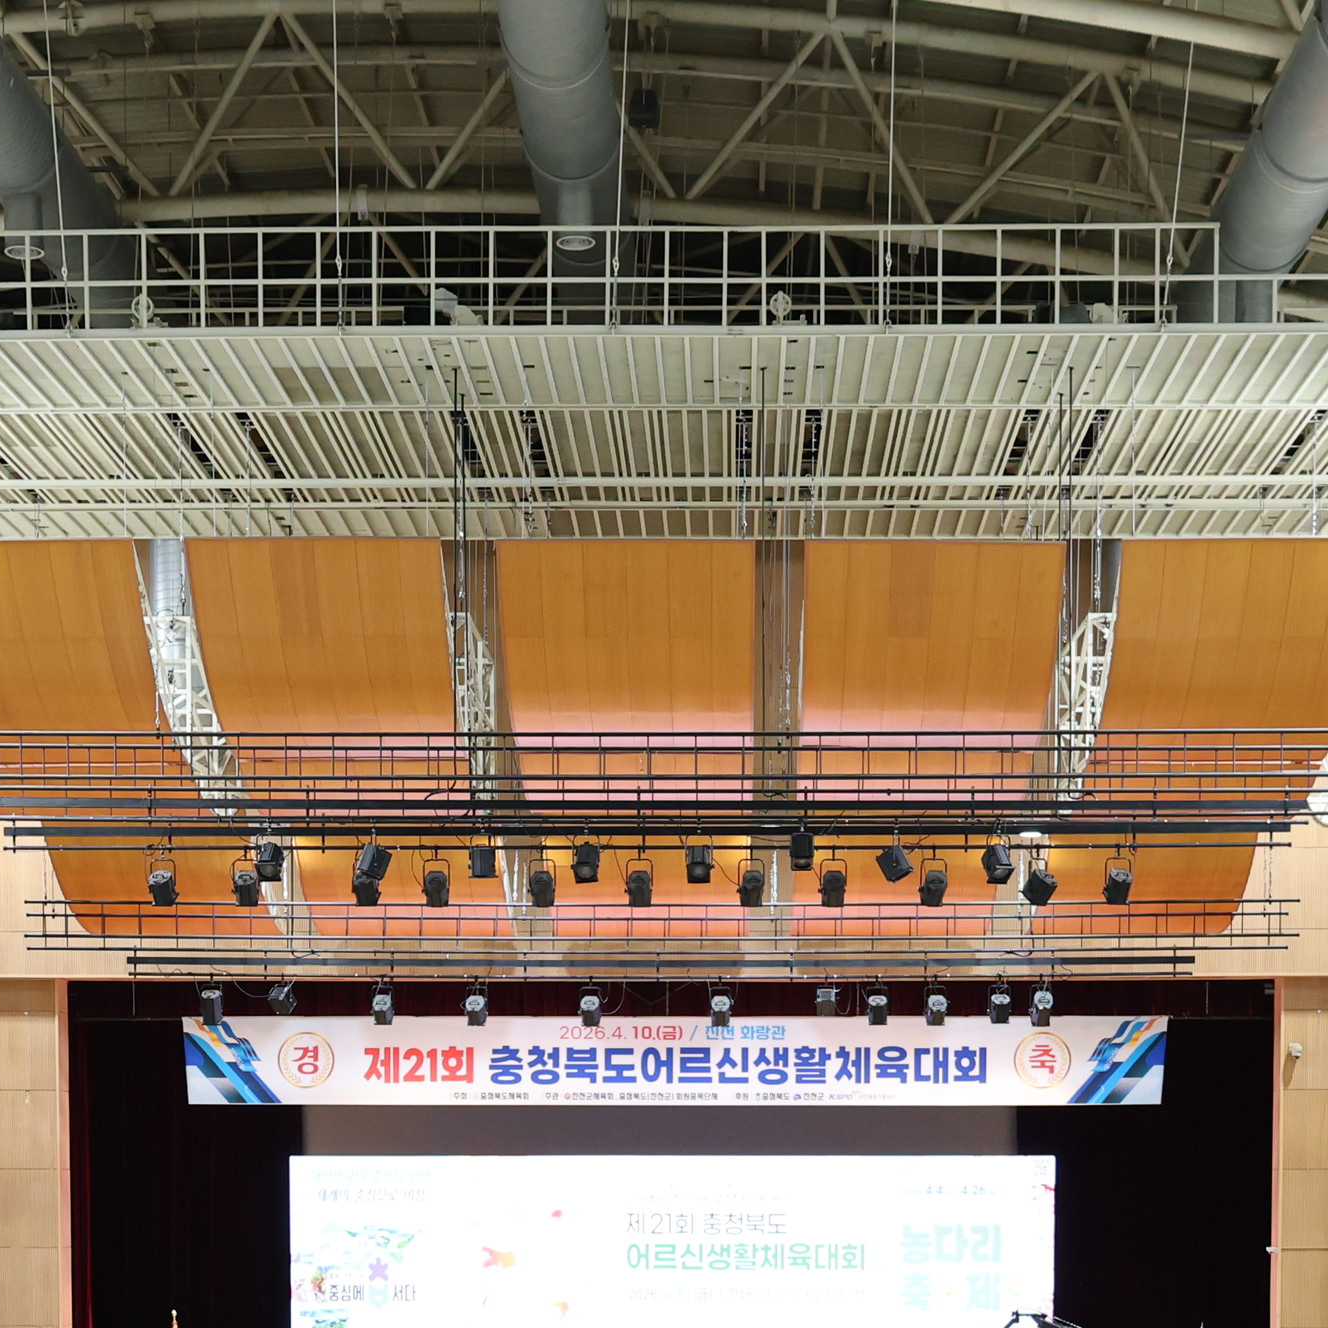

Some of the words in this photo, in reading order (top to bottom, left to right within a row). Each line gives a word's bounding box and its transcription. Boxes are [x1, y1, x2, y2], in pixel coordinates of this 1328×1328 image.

[705, 1025, 735, 1040] 진천
[740, 1025, 786, 1041] 화랑관
[292, 1045, 320, 1075] 경
[363, 1045, 474, 1084] 제21회
[488, 1045, 988, 1086] 충청북도어르신생활체육대회
[1028, 1044, 1058, 1075] 축
[702, 1211, 787, 1236] 충청북도
[626, 1242, 866, 1271] 어르신생활체육대회
[899, 1223, 1003, 1265] 농다리
[329, 1284, 365, 1302] 중심에
[392, 1284, 416, 1302] 서다
